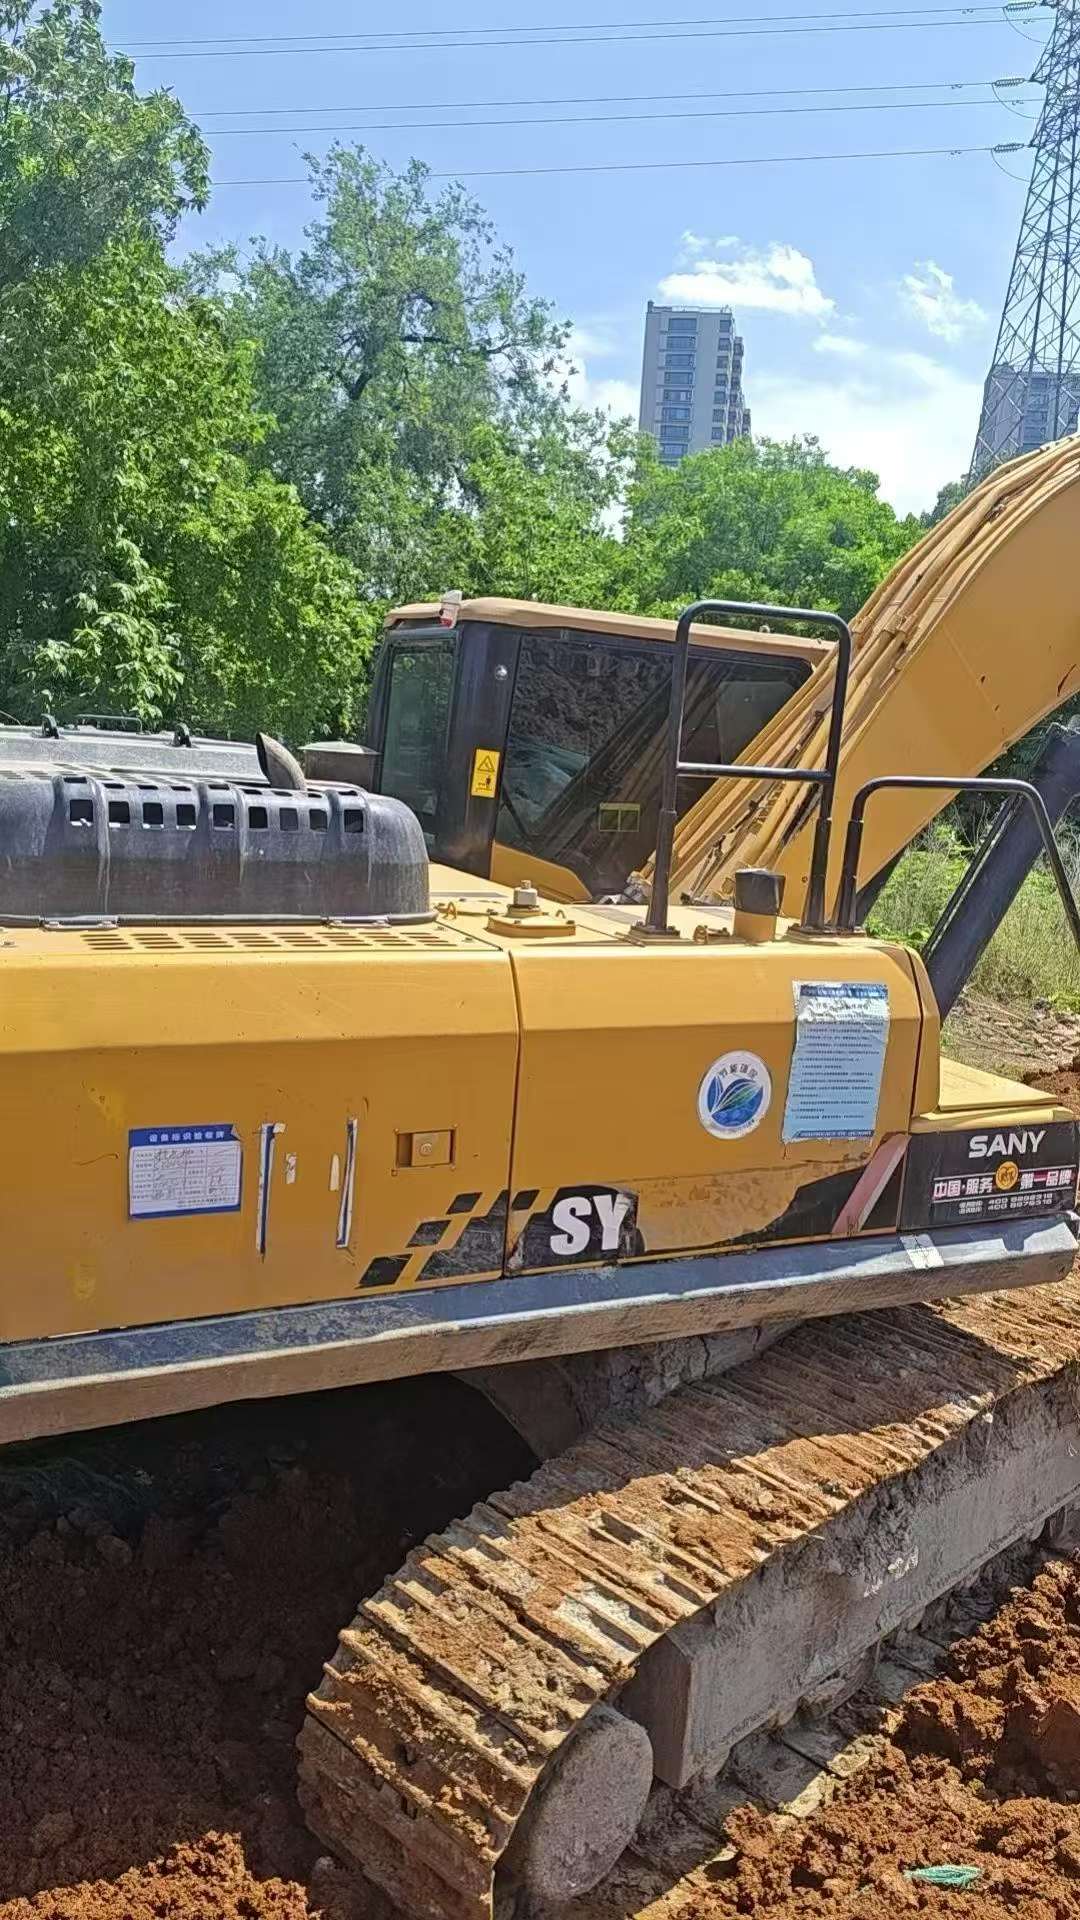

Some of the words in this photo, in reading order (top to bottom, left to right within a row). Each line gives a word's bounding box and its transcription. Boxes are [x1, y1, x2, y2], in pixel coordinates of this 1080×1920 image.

[968, 1130, 1046, 1159] SANY
[1020, 1169, 1073, 1190] 第一品牌
[550, 1193, 630, 1256] SY
